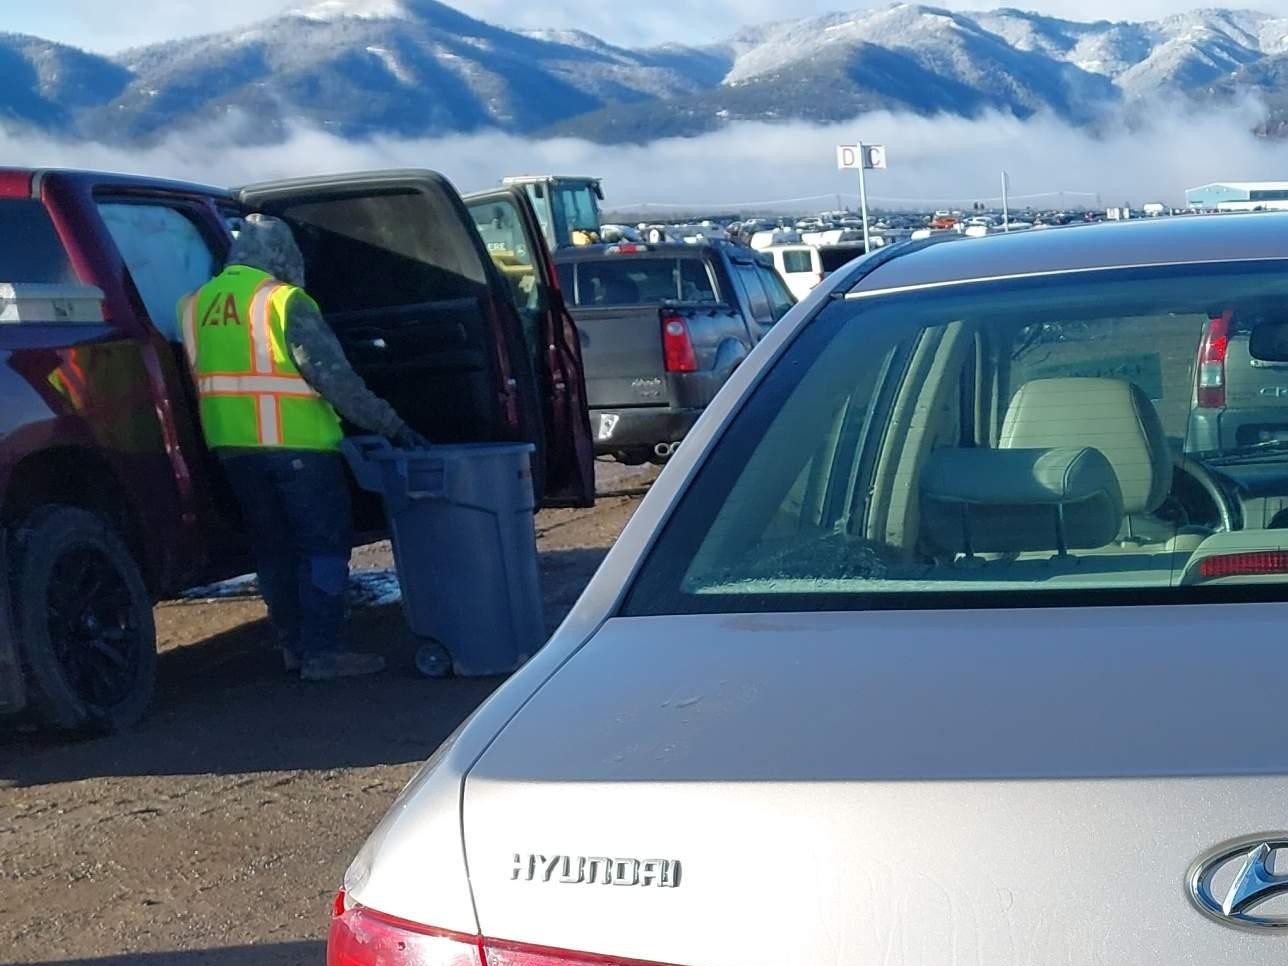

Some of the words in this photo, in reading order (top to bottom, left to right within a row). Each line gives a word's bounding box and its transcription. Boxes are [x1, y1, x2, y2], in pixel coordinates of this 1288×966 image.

[842, 148, 855, 166] D
[869, 148, 880, 166] C
[510, 852, 683, 888] HYUNDAI
